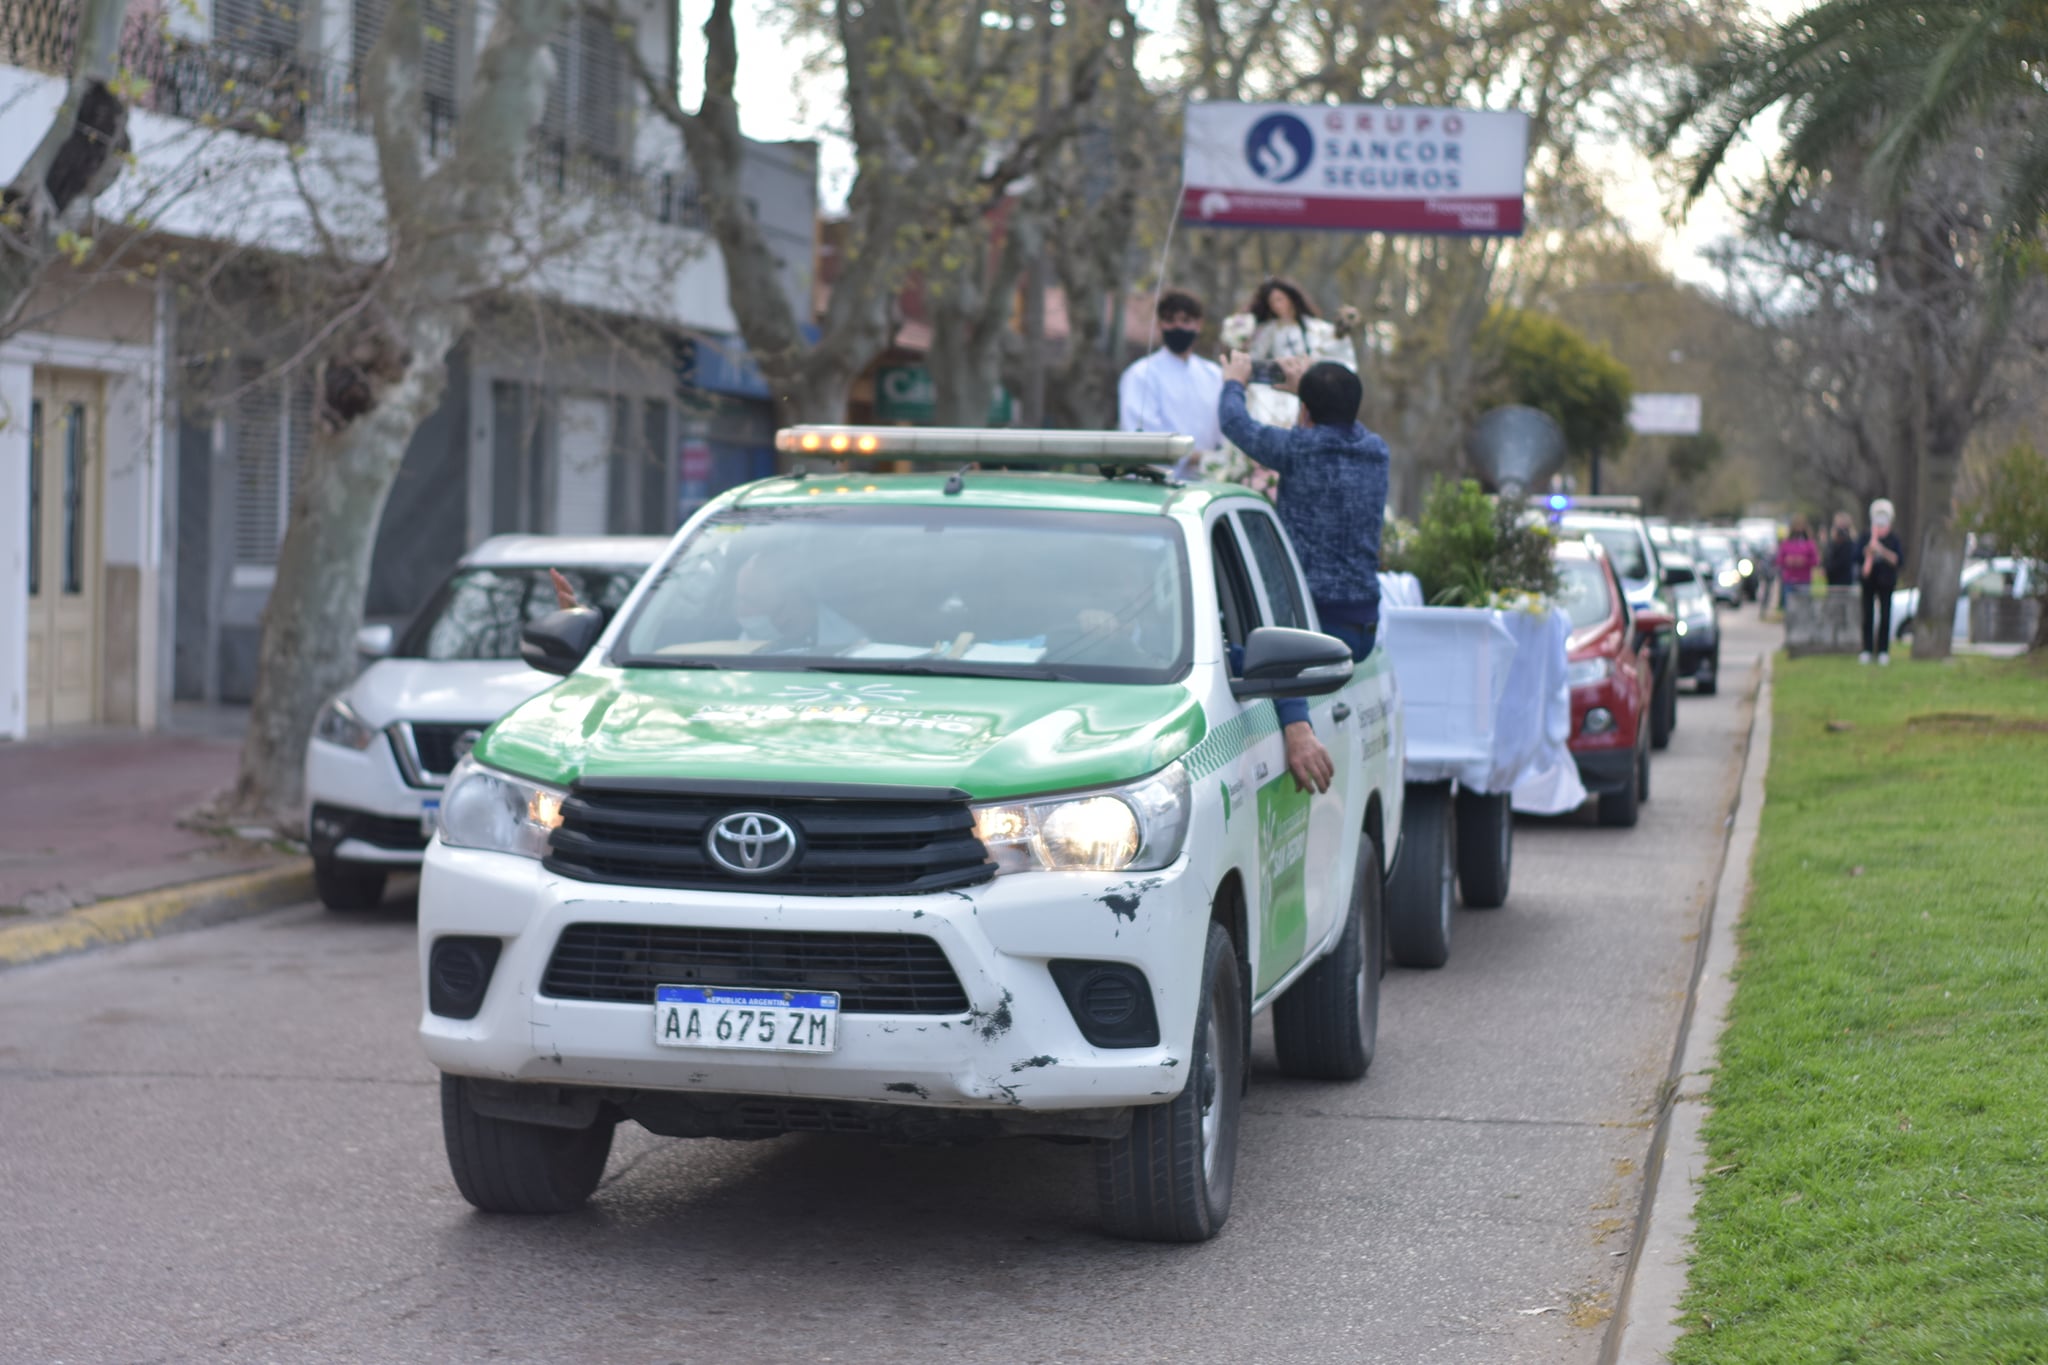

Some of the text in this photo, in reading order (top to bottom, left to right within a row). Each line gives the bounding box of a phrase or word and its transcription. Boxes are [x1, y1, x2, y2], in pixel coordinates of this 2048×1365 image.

[1324, 111, 1464, 136] GRUPO
[1323, 141, 1462, 163] SANCOR
[1323, 167, 1461, 189] SEGUROS
[748, 998, 790, 1007] ARGENTINA
[665, 1007, 827, 1046] AA 675 ZM
